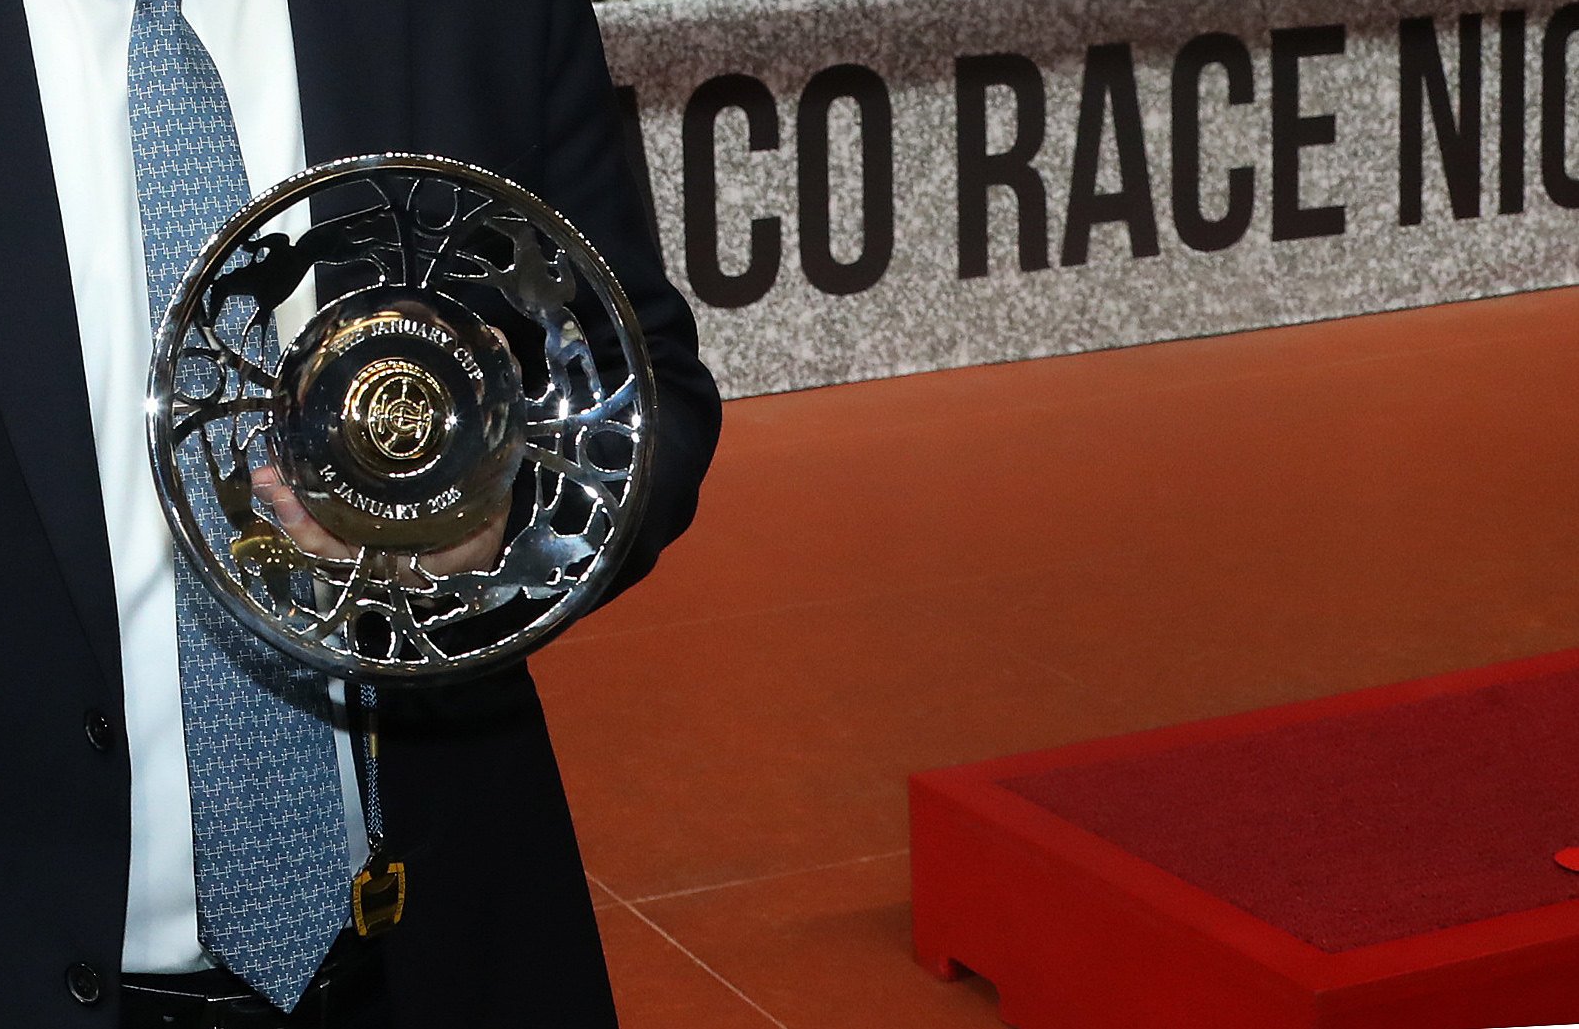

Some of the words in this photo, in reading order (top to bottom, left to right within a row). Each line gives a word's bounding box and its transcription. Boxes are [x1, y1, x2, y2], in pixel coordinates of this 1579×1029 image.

[954, 24, 1346, 280] RACE
[330, 330, 366, 357] THE
[371, 319, 453, 348] JANUARY
[453, 347, 484, 380] CUP
[319, 463, 337, 482] 14
[333, 481, 421, 521] JANUARY
[426, 484, 462, 514] 2026
